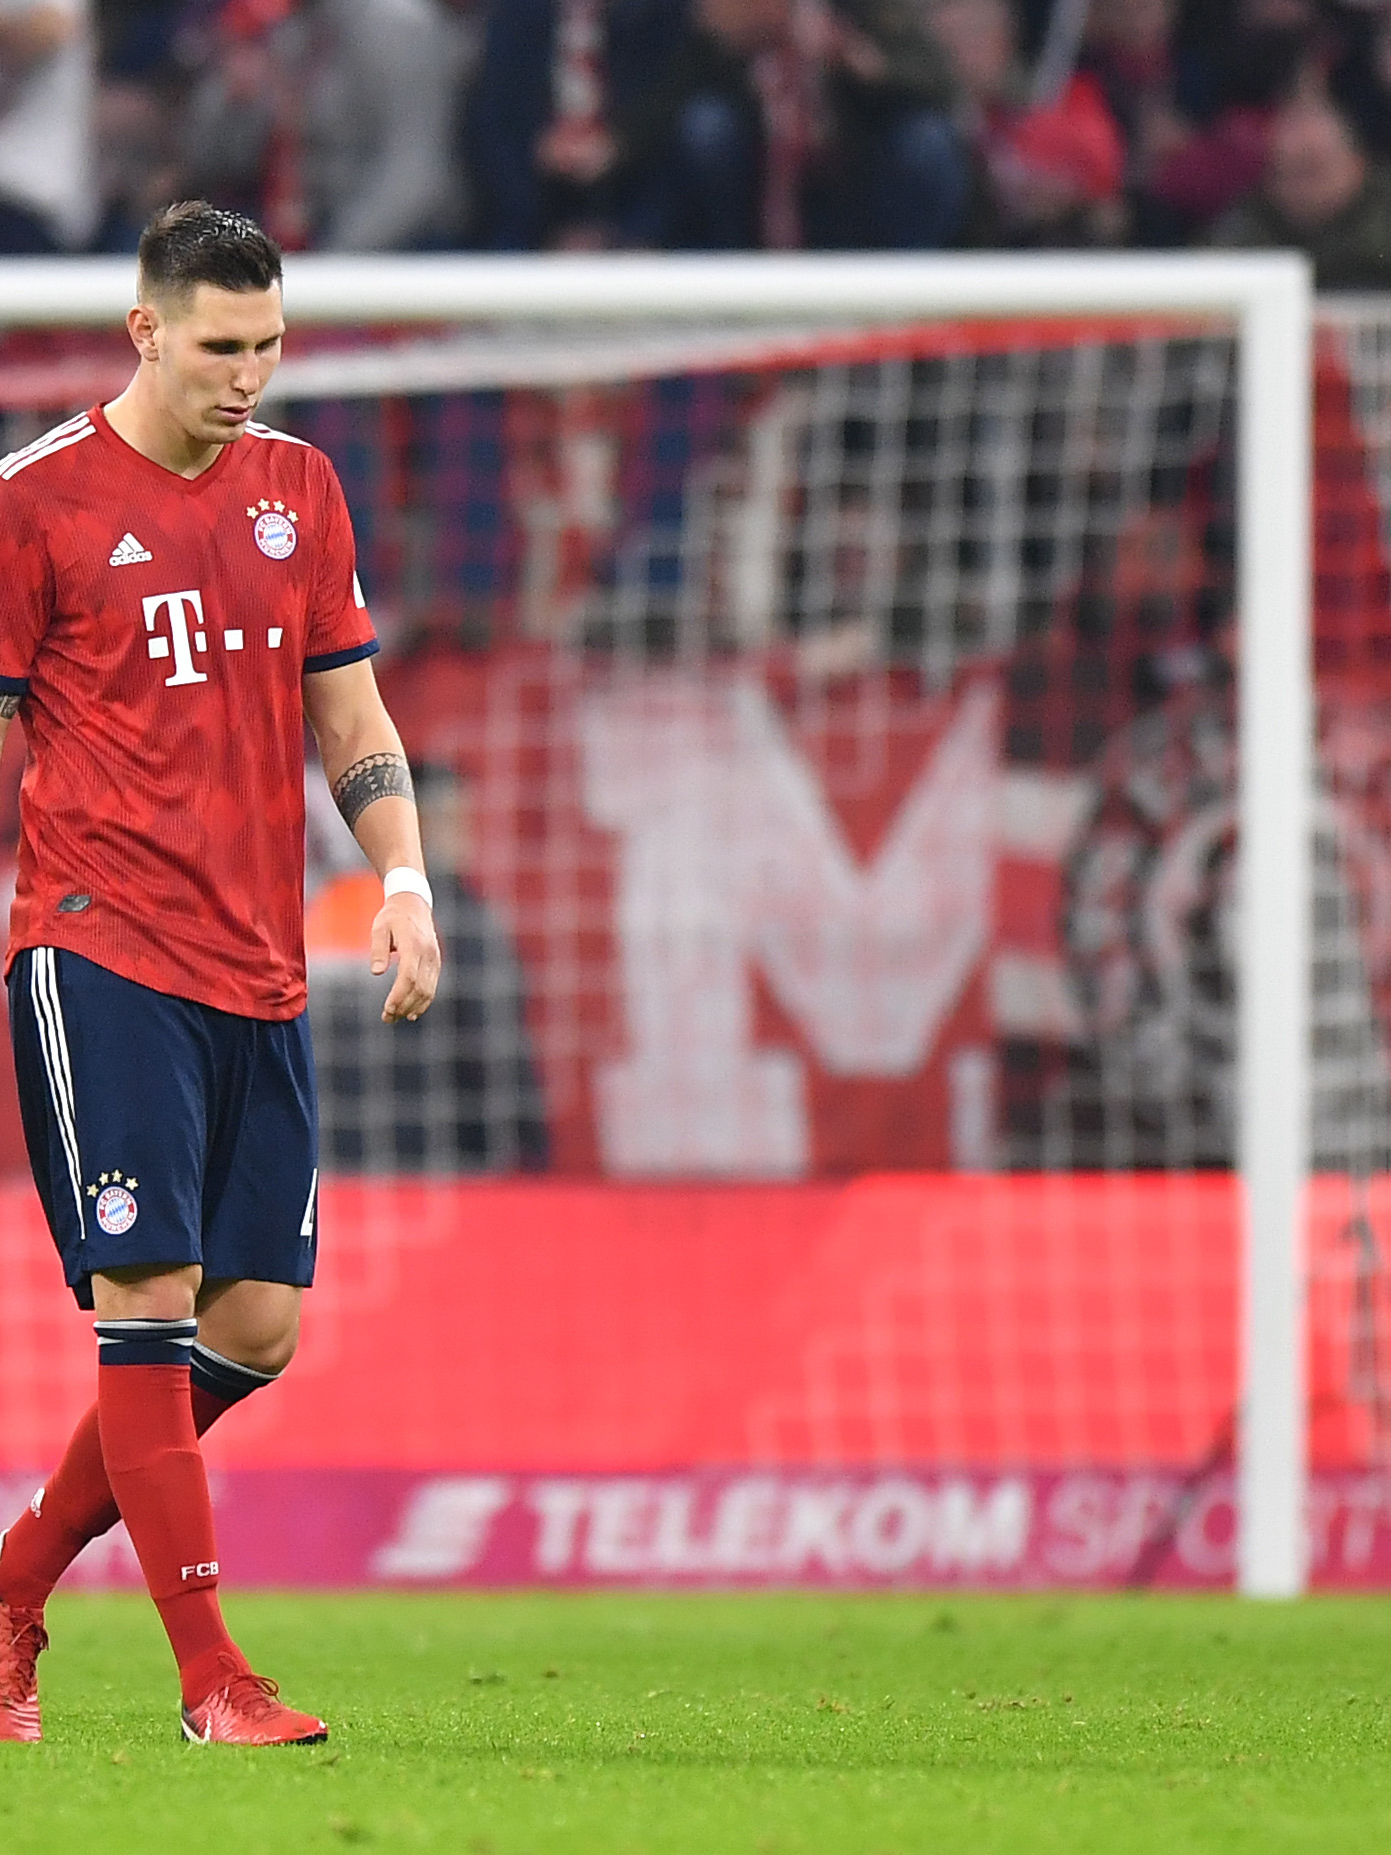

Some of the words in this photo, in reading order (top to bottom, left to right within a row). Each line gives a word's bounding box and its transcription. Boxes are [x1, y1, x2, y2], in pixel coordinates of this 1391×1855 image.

[109, 550, 153, 567] adidas
[532, 1478, 1032, 1577] TELEKOM
[181, 1561, 219, 1581] FCB
